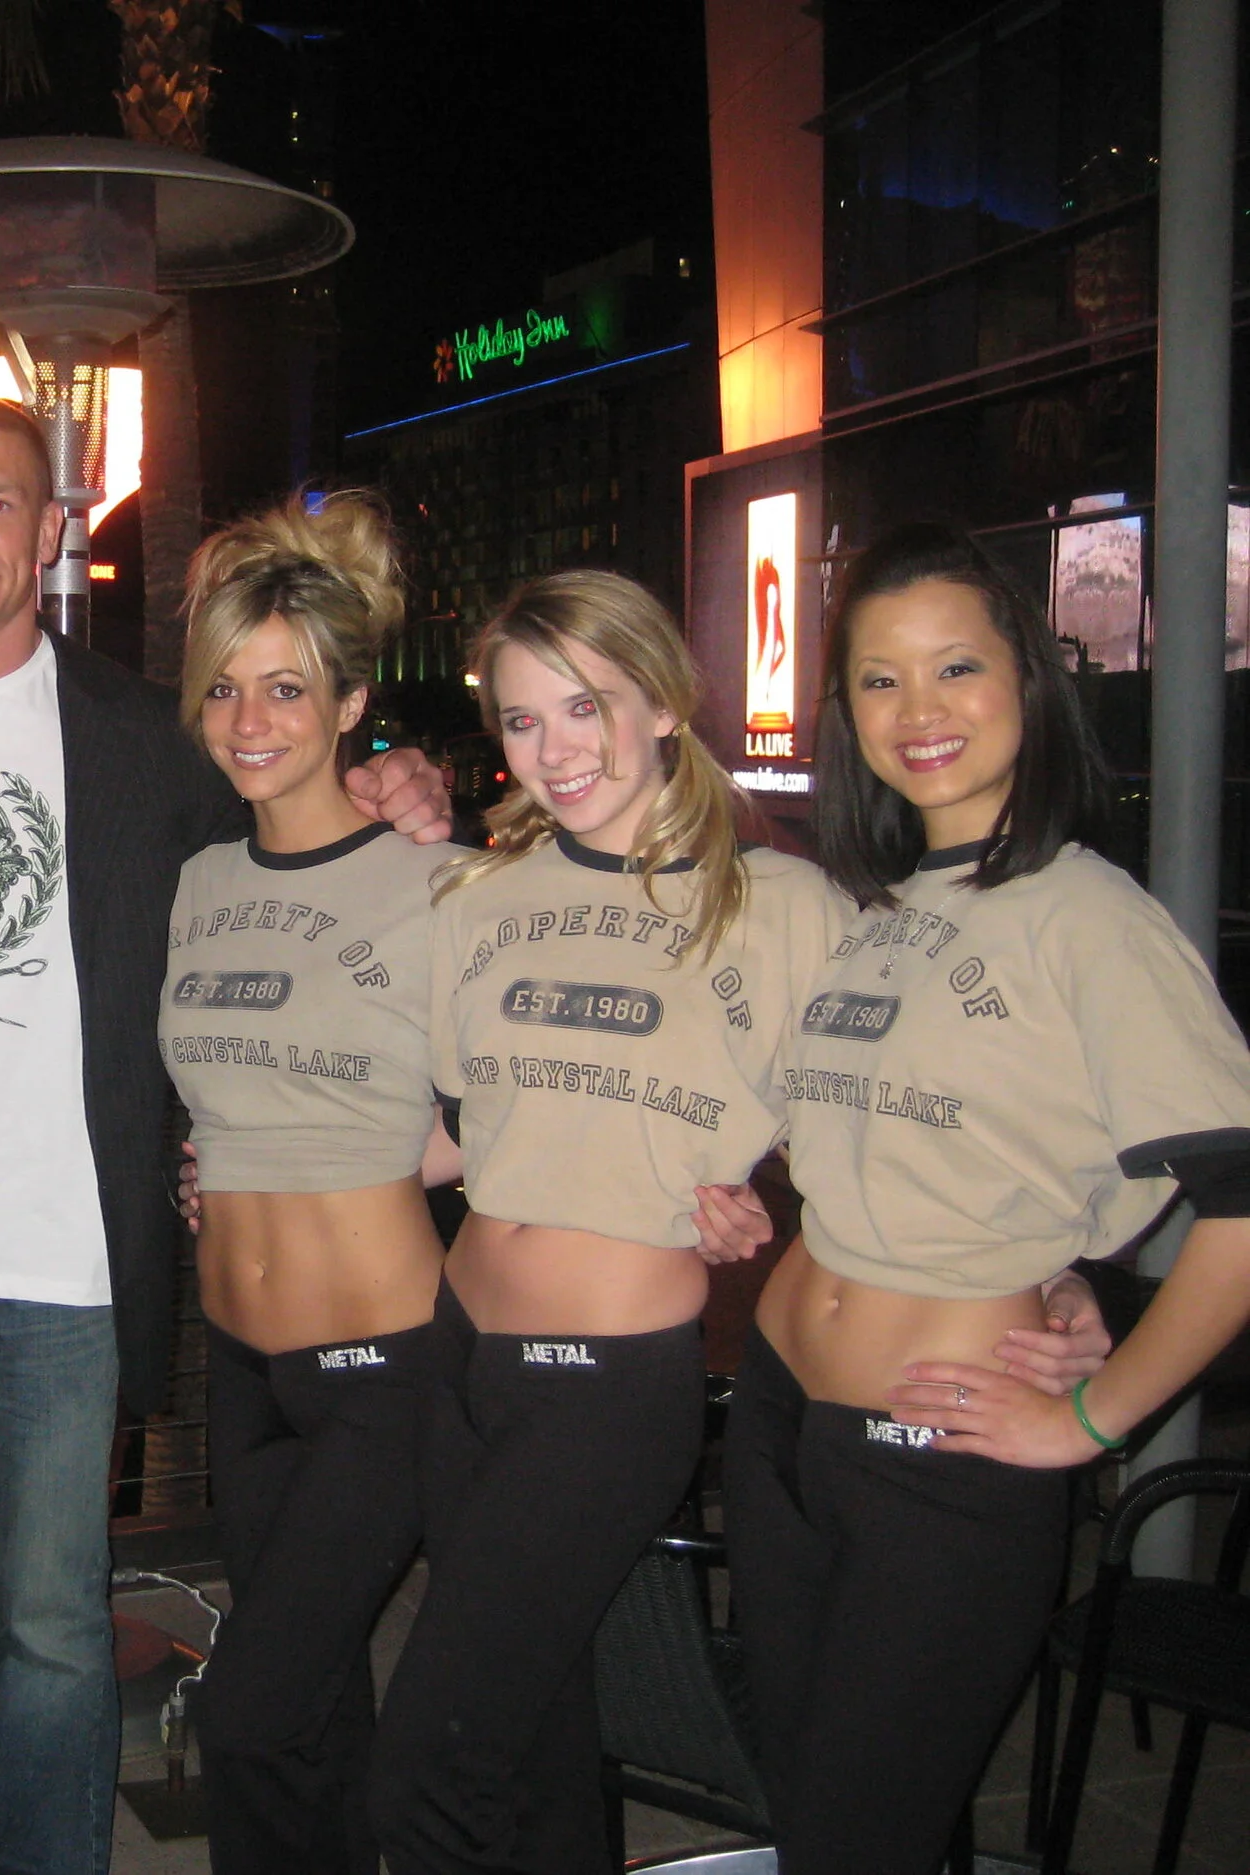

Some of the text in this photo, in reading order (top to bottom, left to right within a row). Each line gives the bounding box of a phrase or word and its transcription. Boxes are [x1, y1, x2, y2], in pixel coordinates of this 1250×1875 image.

[455, 309, 570, 381] Holiday Inn
[169, 900, 390, 989] ROPERTY OF
[830, 907, 1009, 1021] OPERTY OF
[179, 980, 282, 1001] EST. 1980
[512, 989, 649, 1025] EST. 1980
[711, 965, 752, 1031] OF
[806, 1001, 890, 1029] EST. 1980
[171, 1036, 278, 1068] CRYSTAL
[287, 1045, 371, 1081] LAKE
[642, 1076, 726, 1131] LAKE
[876, 1081, 963, 1129] LAKE
[316, 1345, 386, 1370] METAL
[521, 1342, 597, 1366] METAL
